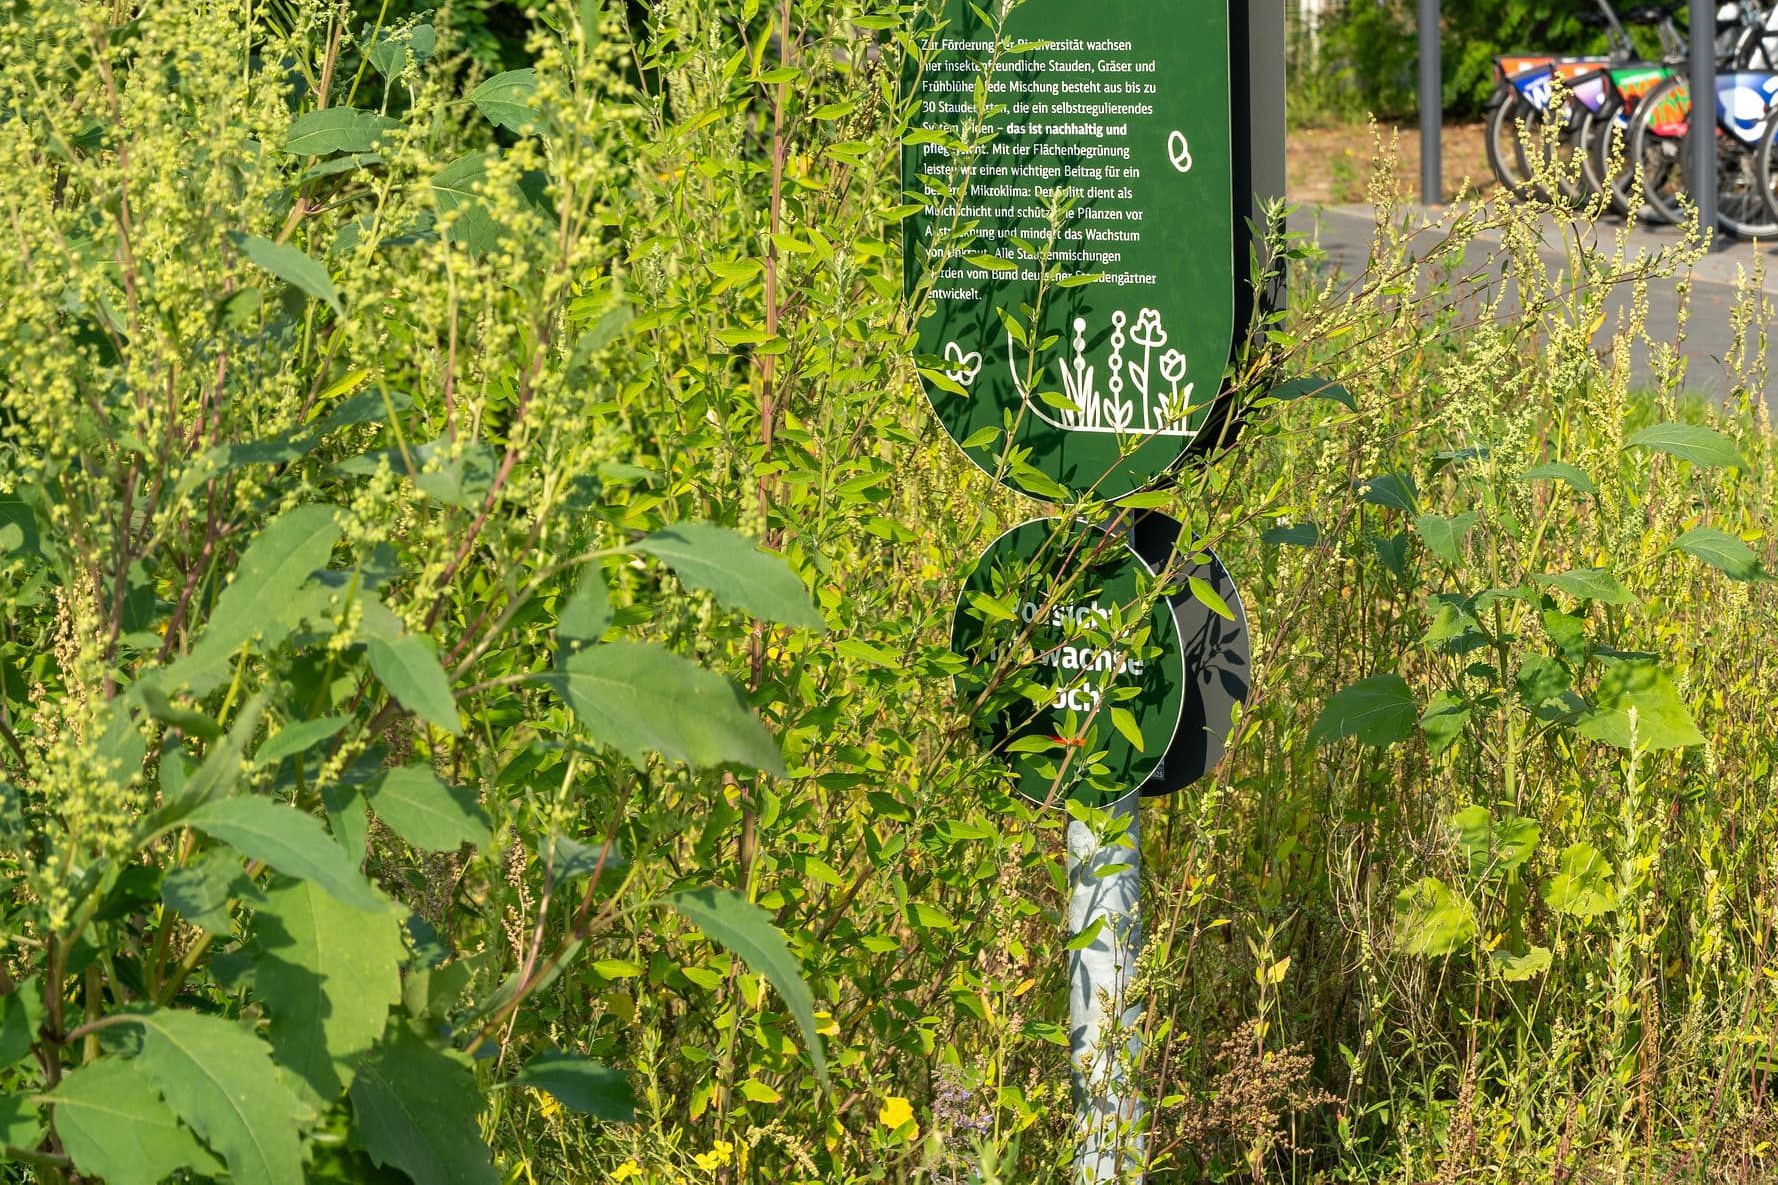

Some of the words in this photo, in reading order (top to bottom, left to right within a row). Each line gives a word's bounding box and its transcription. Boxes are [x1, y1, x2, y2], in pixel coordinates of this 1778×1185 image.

[942, 38, 995, 54] Förderung
[1086, 39, 1132, 51] wachsen
[1048, 59, 1095, 74] Stauden,
[1097, 60, 1133, 72] Gräser
[1135, 59, 1156, 72] und
[1009, 80, 1059, 96] Mischung
[1061, 81, 1102, 93] besteht
[1103, 84, 1122, 93] aus
[1125, 81, 1141, 93] bis
[1143, 84, 1157, 93] zu
[922, 101, 936, 113] 30
[1012, 102, 1030, 113] die
[1032, 102, 1048, 113] ein
[1051, 102, 1153, 116] selbstregulierendes
[1006, 122, 1026, 134] das
[1028, 123, 1043, 134] ist
[1045, 123, 1104, 138] nachhaltig
[1106, 123, 1128, 135] und
[992, 144, 1010, 155] Mit
[1013, 144, 1030, 155] der
[1033, 144, 1130, 159] Flächenbegrünung
[979, 164, 1008, 175] einen
[1011, 164, 1061, 179] wichtigen
[1064, 165, 1102, 180] Beitrag
[1105, 166, 1121, 177] für
[1123, 166, 1140, 178] ein
[970, 184, 1032, 197] Mikroklima:
[1087, 186, 1115, 198] dient
[1117, 187, 1133, 199] als
[995, 205, 1014, 217] und
[1077, 207, 1123, 220] Pflanzen
[1126, 211, 1144, 220] vor
[998, 226, 1017, 238] und
[1064, 228, 1083, 240] das
[1086, 228, 1140, 241] Wachstum
[995, 248, 1015, 260] Alle
[966, 270, 989, 280] vom
[992, 269, 1018, 281] Bund
[928, 287, 982, 300] entwickelt.
